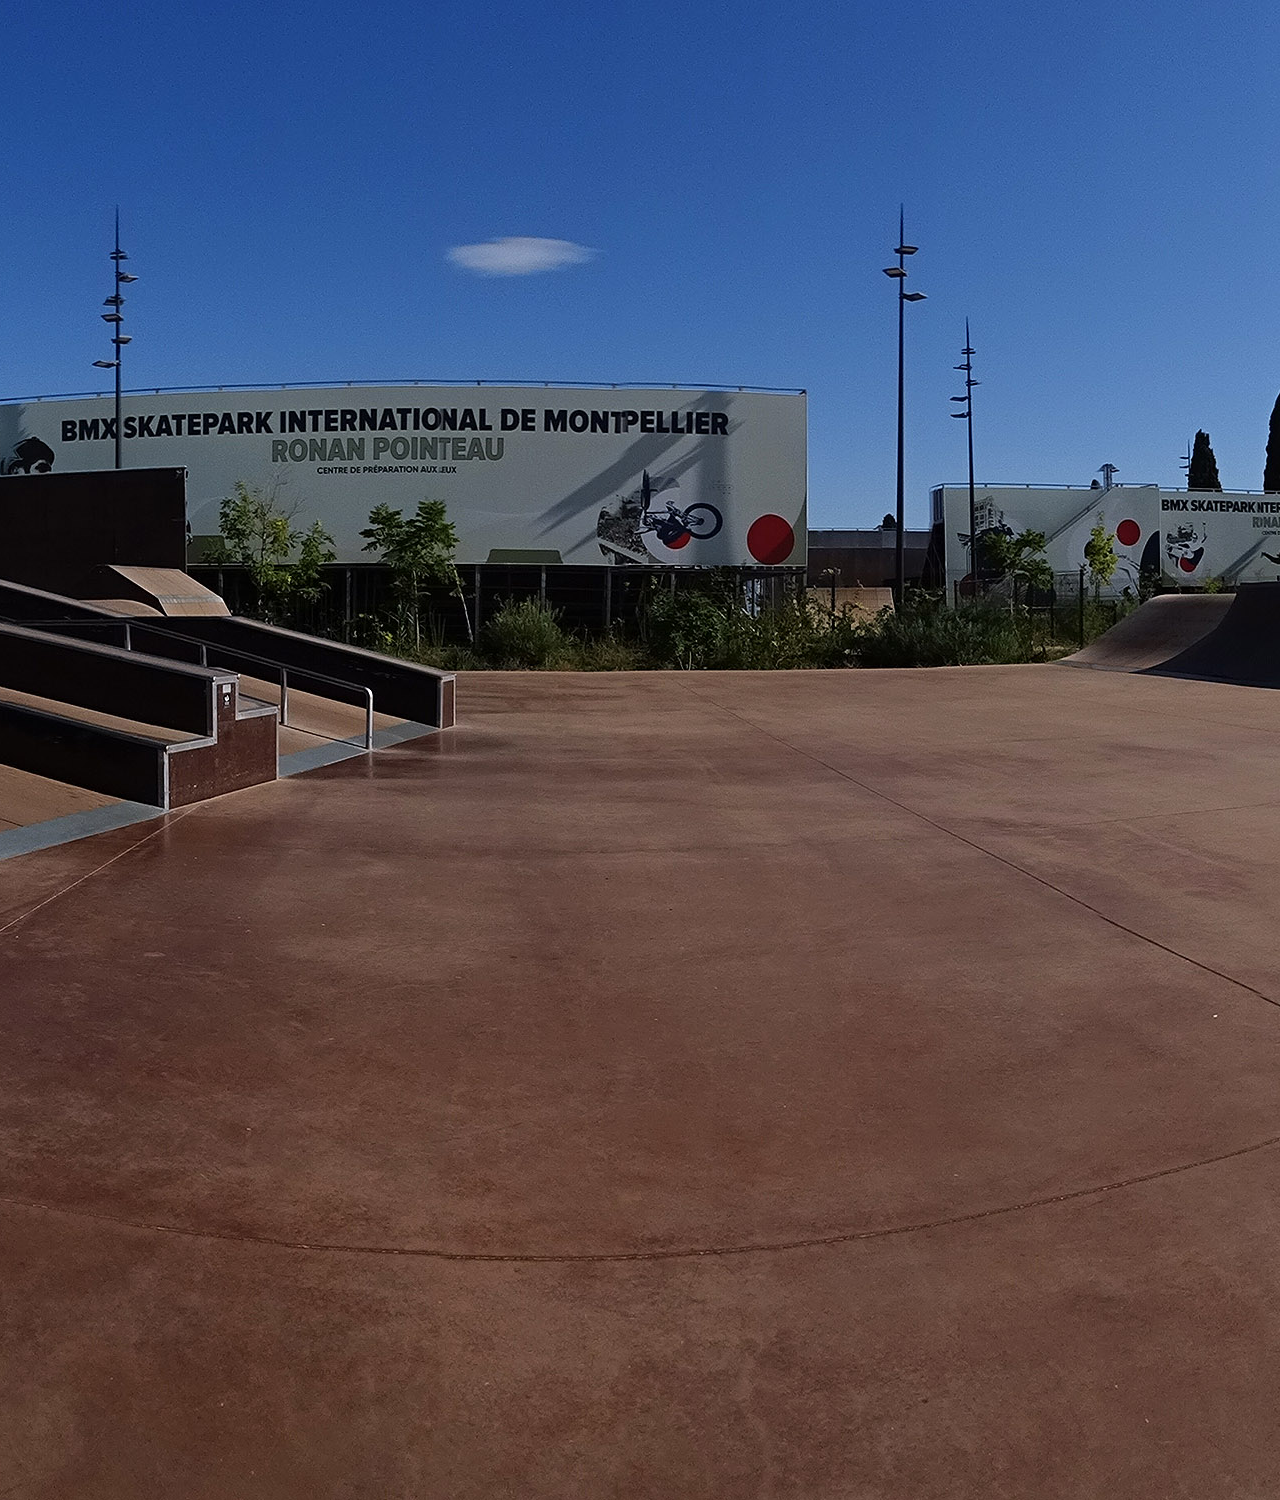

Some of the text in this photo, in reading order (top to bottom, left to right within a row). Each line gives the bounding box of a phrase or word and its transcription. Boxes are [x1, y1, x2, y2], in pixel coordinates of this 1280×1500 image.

[61, 407, 729, 442] BMX SKATEPARK INTERNATIONAL DE MONTPELLIER
[271, 436, 505, 463] RONAN POINTEAU
[316, 466, 348, 475] CENTRE
[350, 466, 361, 474] DE
[362, 464, 419, 474] PRÉPARATION
[420, 465, 438, 473] AUX
[1161, 499, 1189, 512] BMX
[1190, 499, 1256, 513] SKATEPARK
